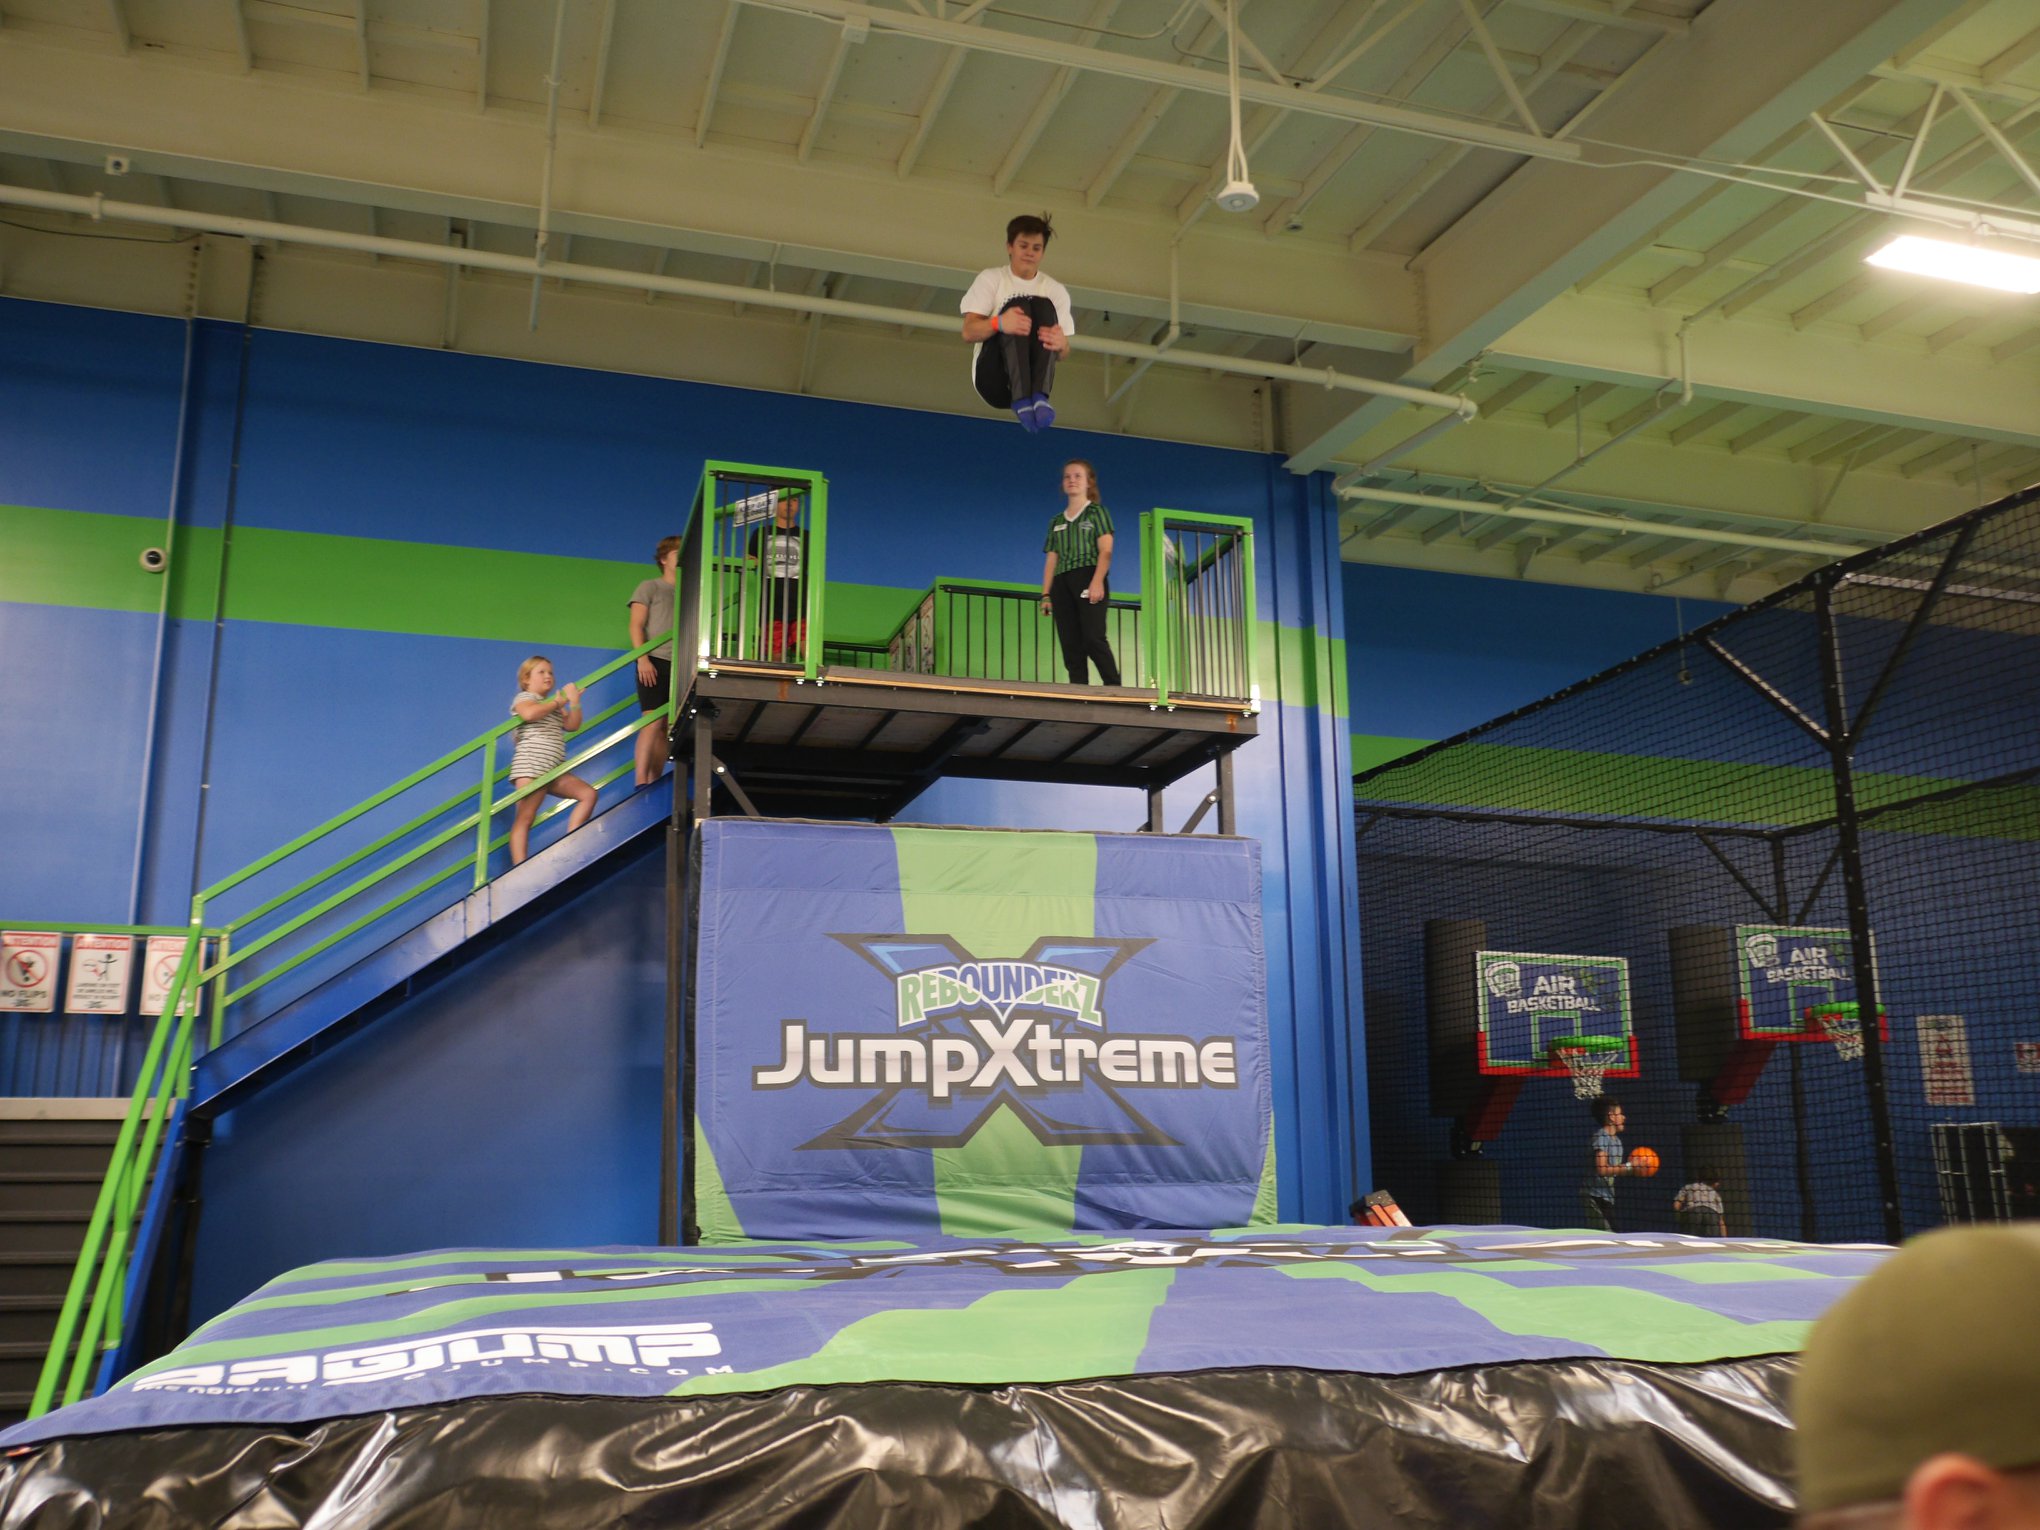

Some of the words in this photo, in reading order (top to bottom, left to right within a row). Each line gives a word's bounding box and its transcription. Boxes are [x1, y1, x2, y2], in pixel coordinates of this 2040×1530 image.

[1790, 947, 1829, 966] AIR
[1766, 965, 1852, 984] BASKETBALL
[897, 961, 1103, 1028] REBOUNDERZ
[1533, 975, 1578, 996] AIR
[1507, 995, 1602, 1014] BASKETBALL
[756, 1018, 1237, 1098] JumpXtreme
